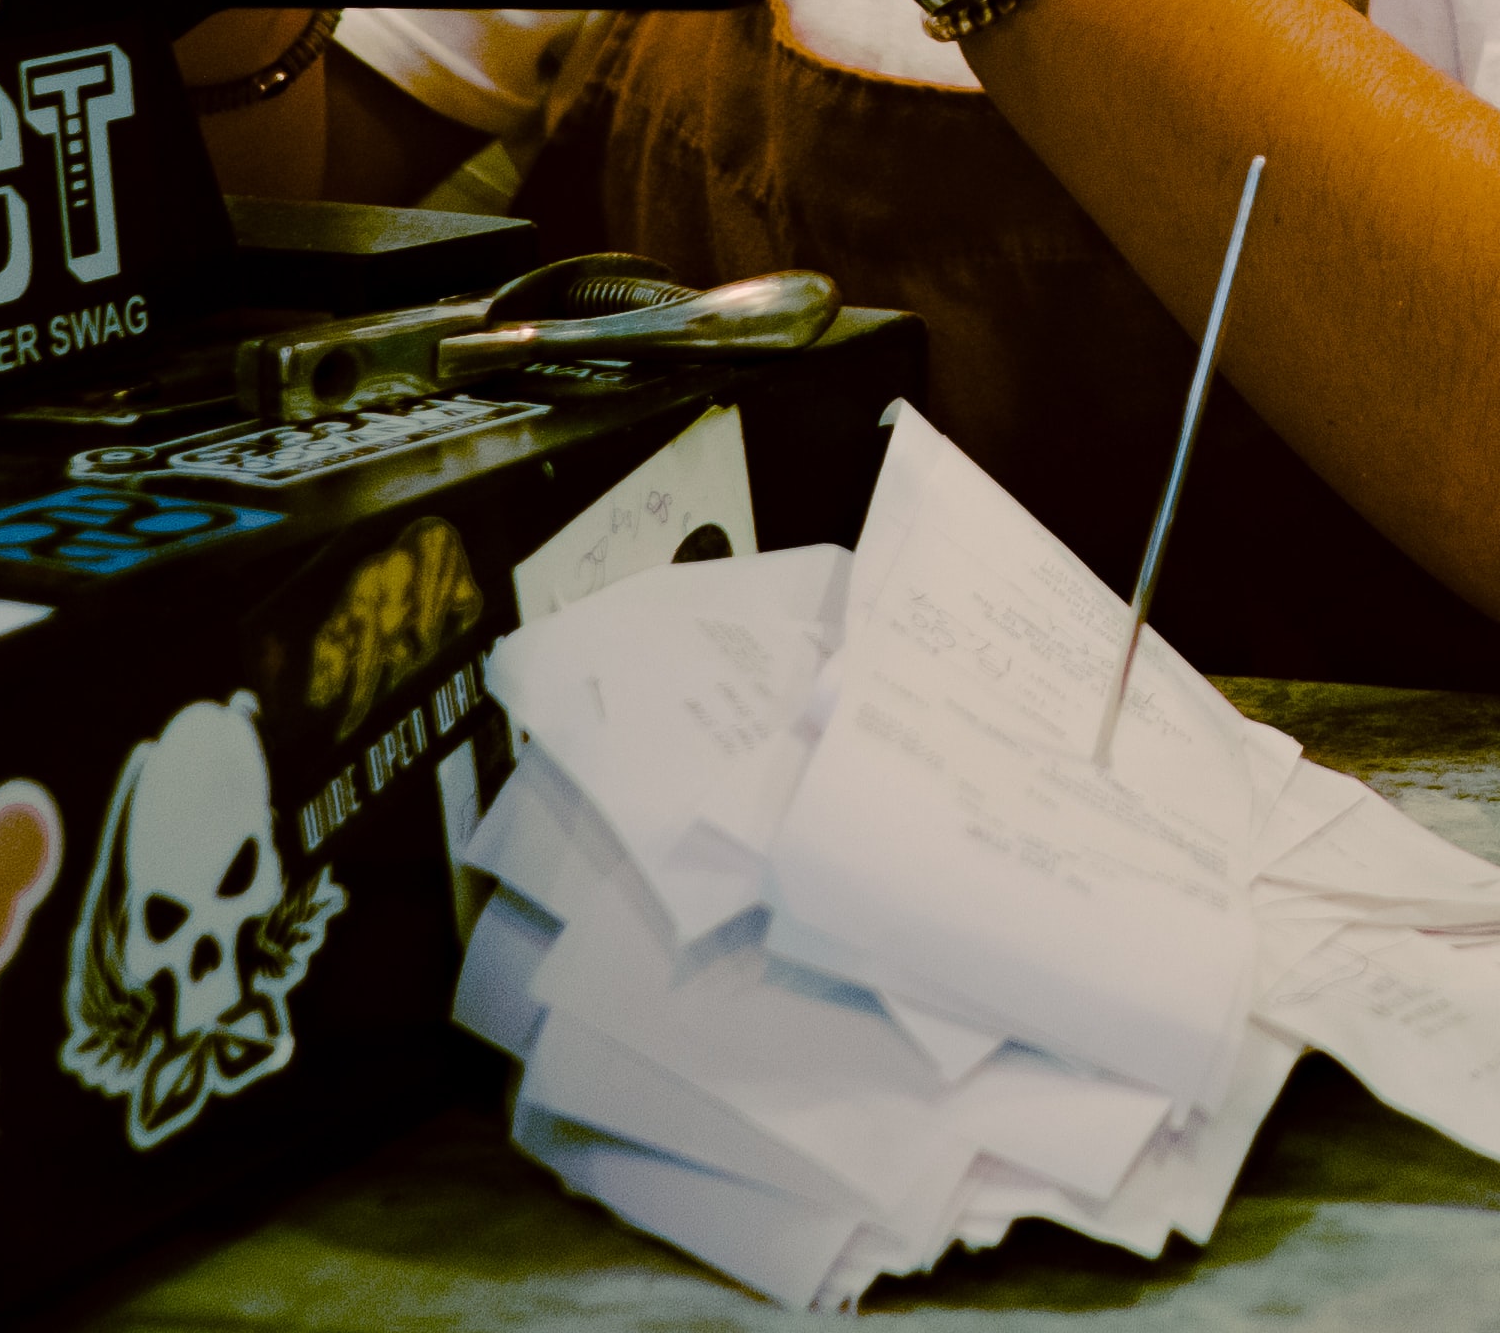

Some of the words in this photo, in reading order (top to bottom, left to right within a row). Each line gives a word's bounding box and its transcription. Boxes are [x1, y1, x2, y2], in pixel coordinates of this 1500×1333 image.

[49, 294, 152, 356] SWAG
[302, 767, 362, 852] WIDE
[367, 707, 430, 797] OPEN
